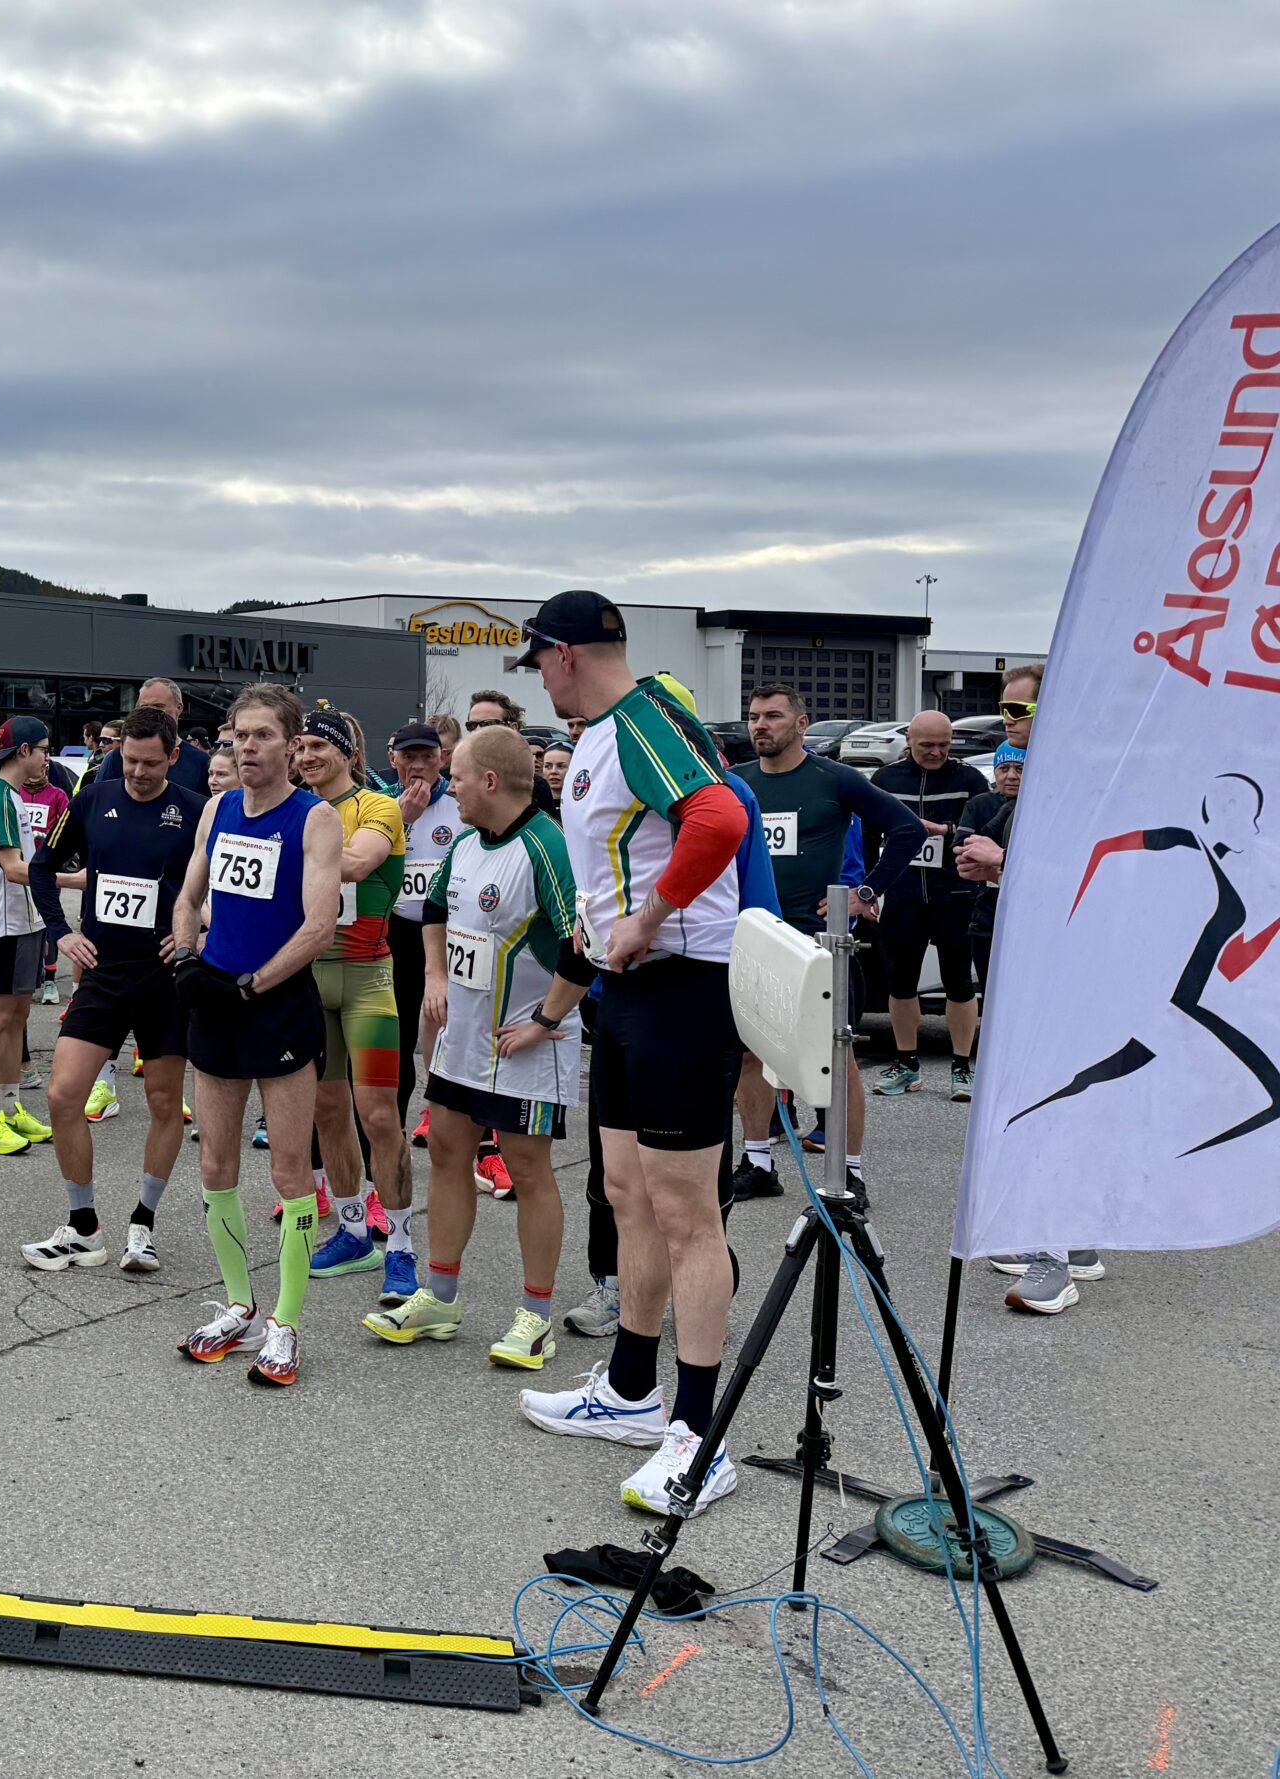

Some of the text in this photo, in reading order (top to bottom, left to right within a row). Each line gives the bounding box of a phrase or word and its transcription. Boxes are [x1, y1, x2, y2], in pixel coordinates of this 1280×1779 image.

[1133, 313, 1280, 688] Ålesund
[193, 634, 319, 673] RENAULT
[218, 852, 263, 890] 753
[103, 890, 147, 920] 737
[447, 942, 476, 980] 721
